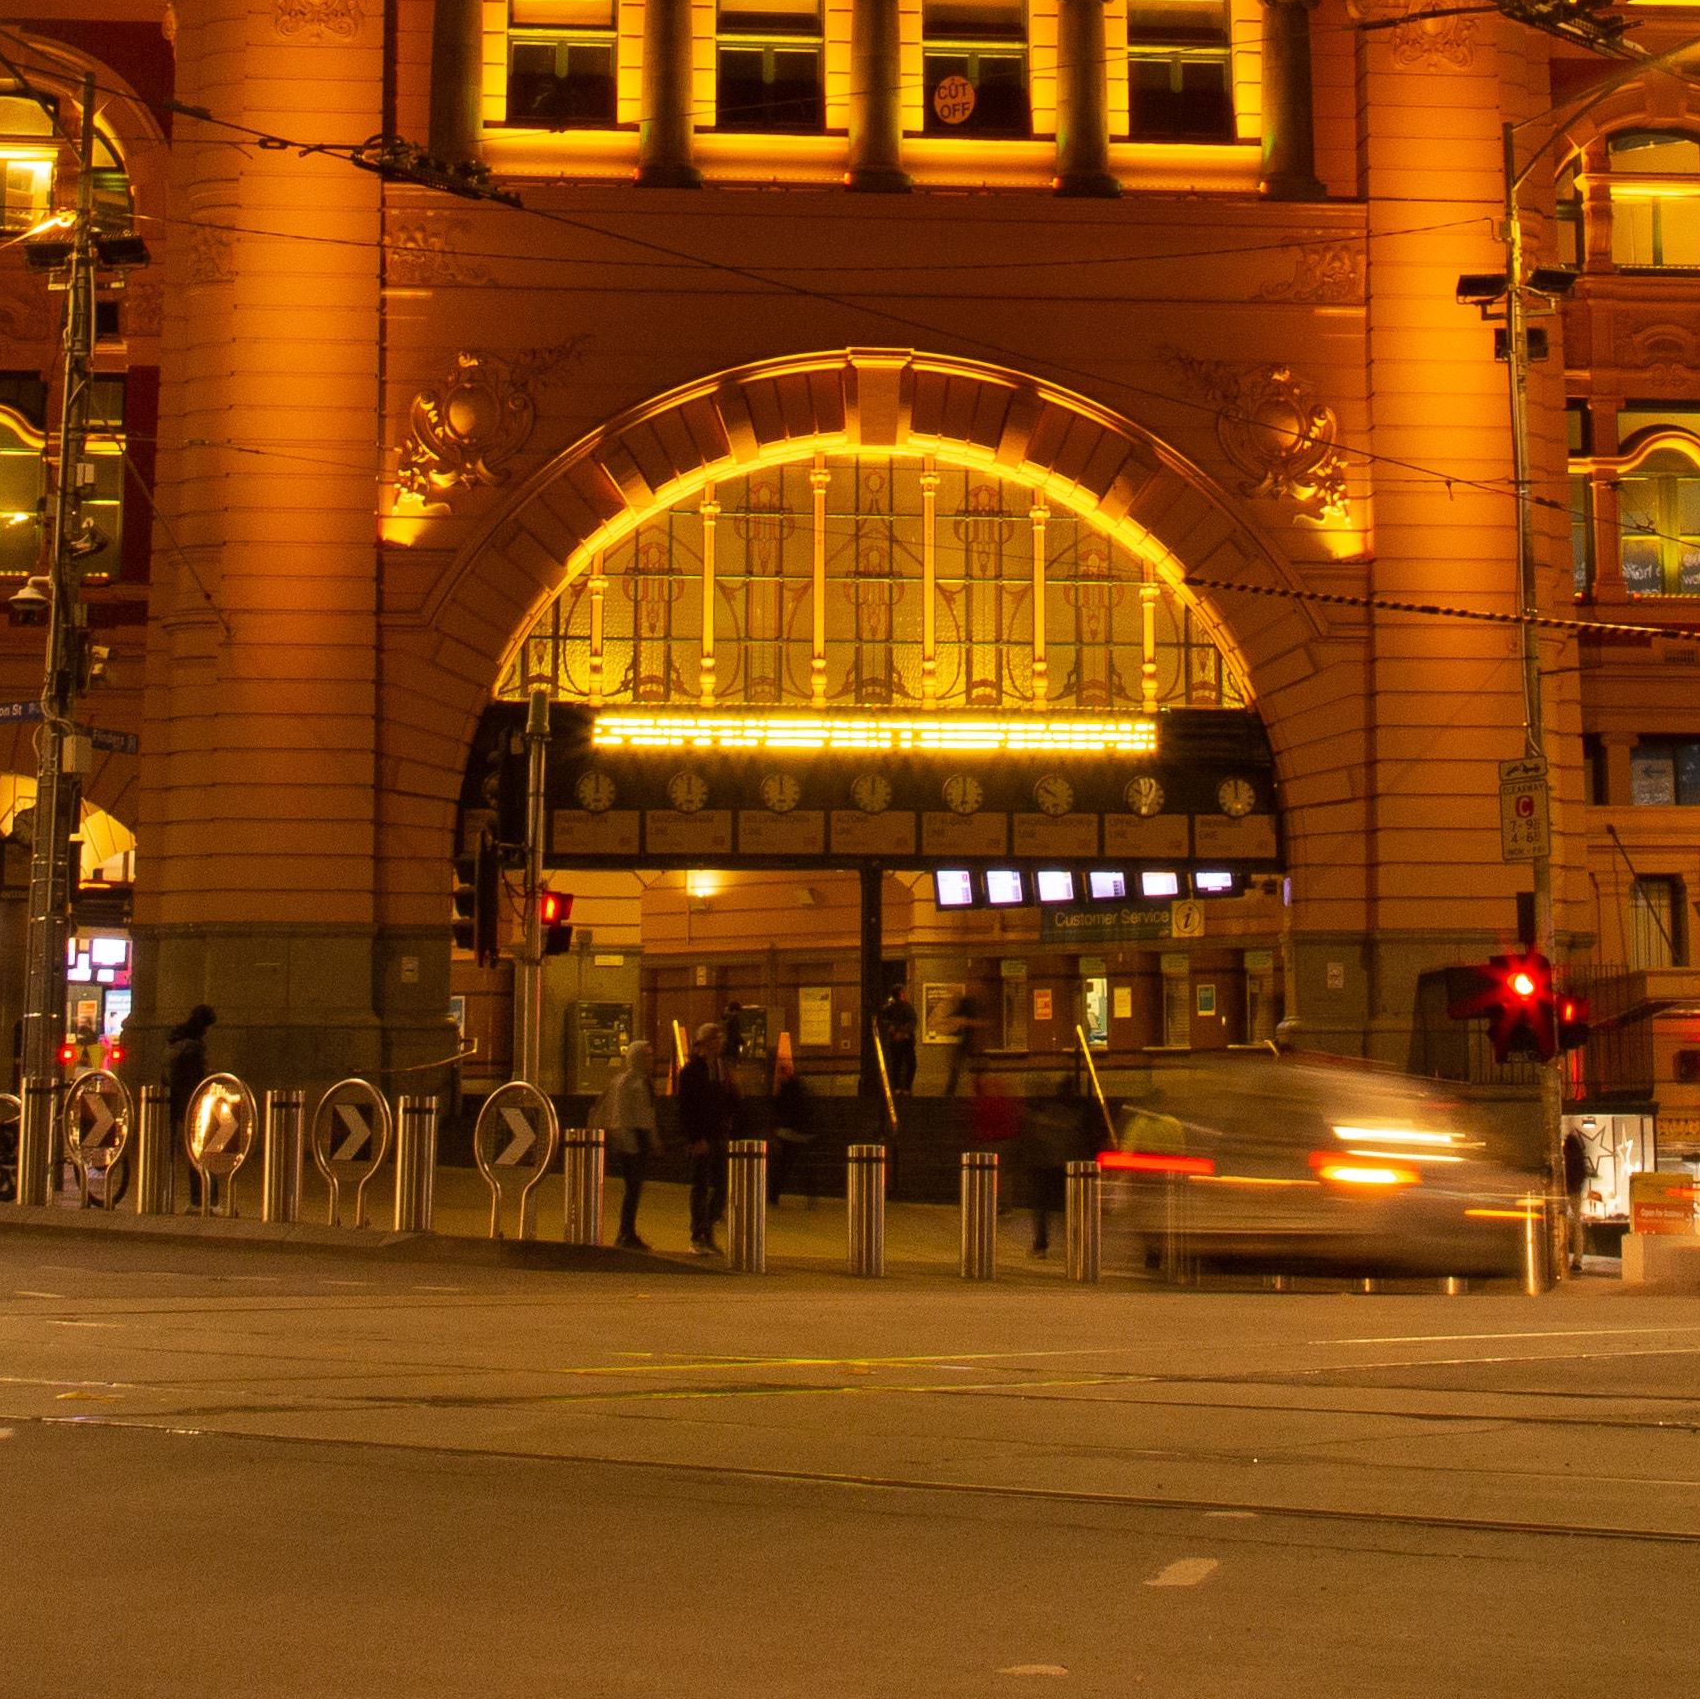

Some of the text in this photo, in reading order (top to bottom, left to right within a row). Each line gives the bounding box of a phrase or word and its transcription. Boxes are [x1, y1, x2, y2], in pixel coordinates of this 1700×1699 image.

[937, 83, 969, 100] CUT
[940, 102, 970, 119] OFF
[12, 703, 23, 716] St
[1054, 907, 1169, 927] Customer Service
